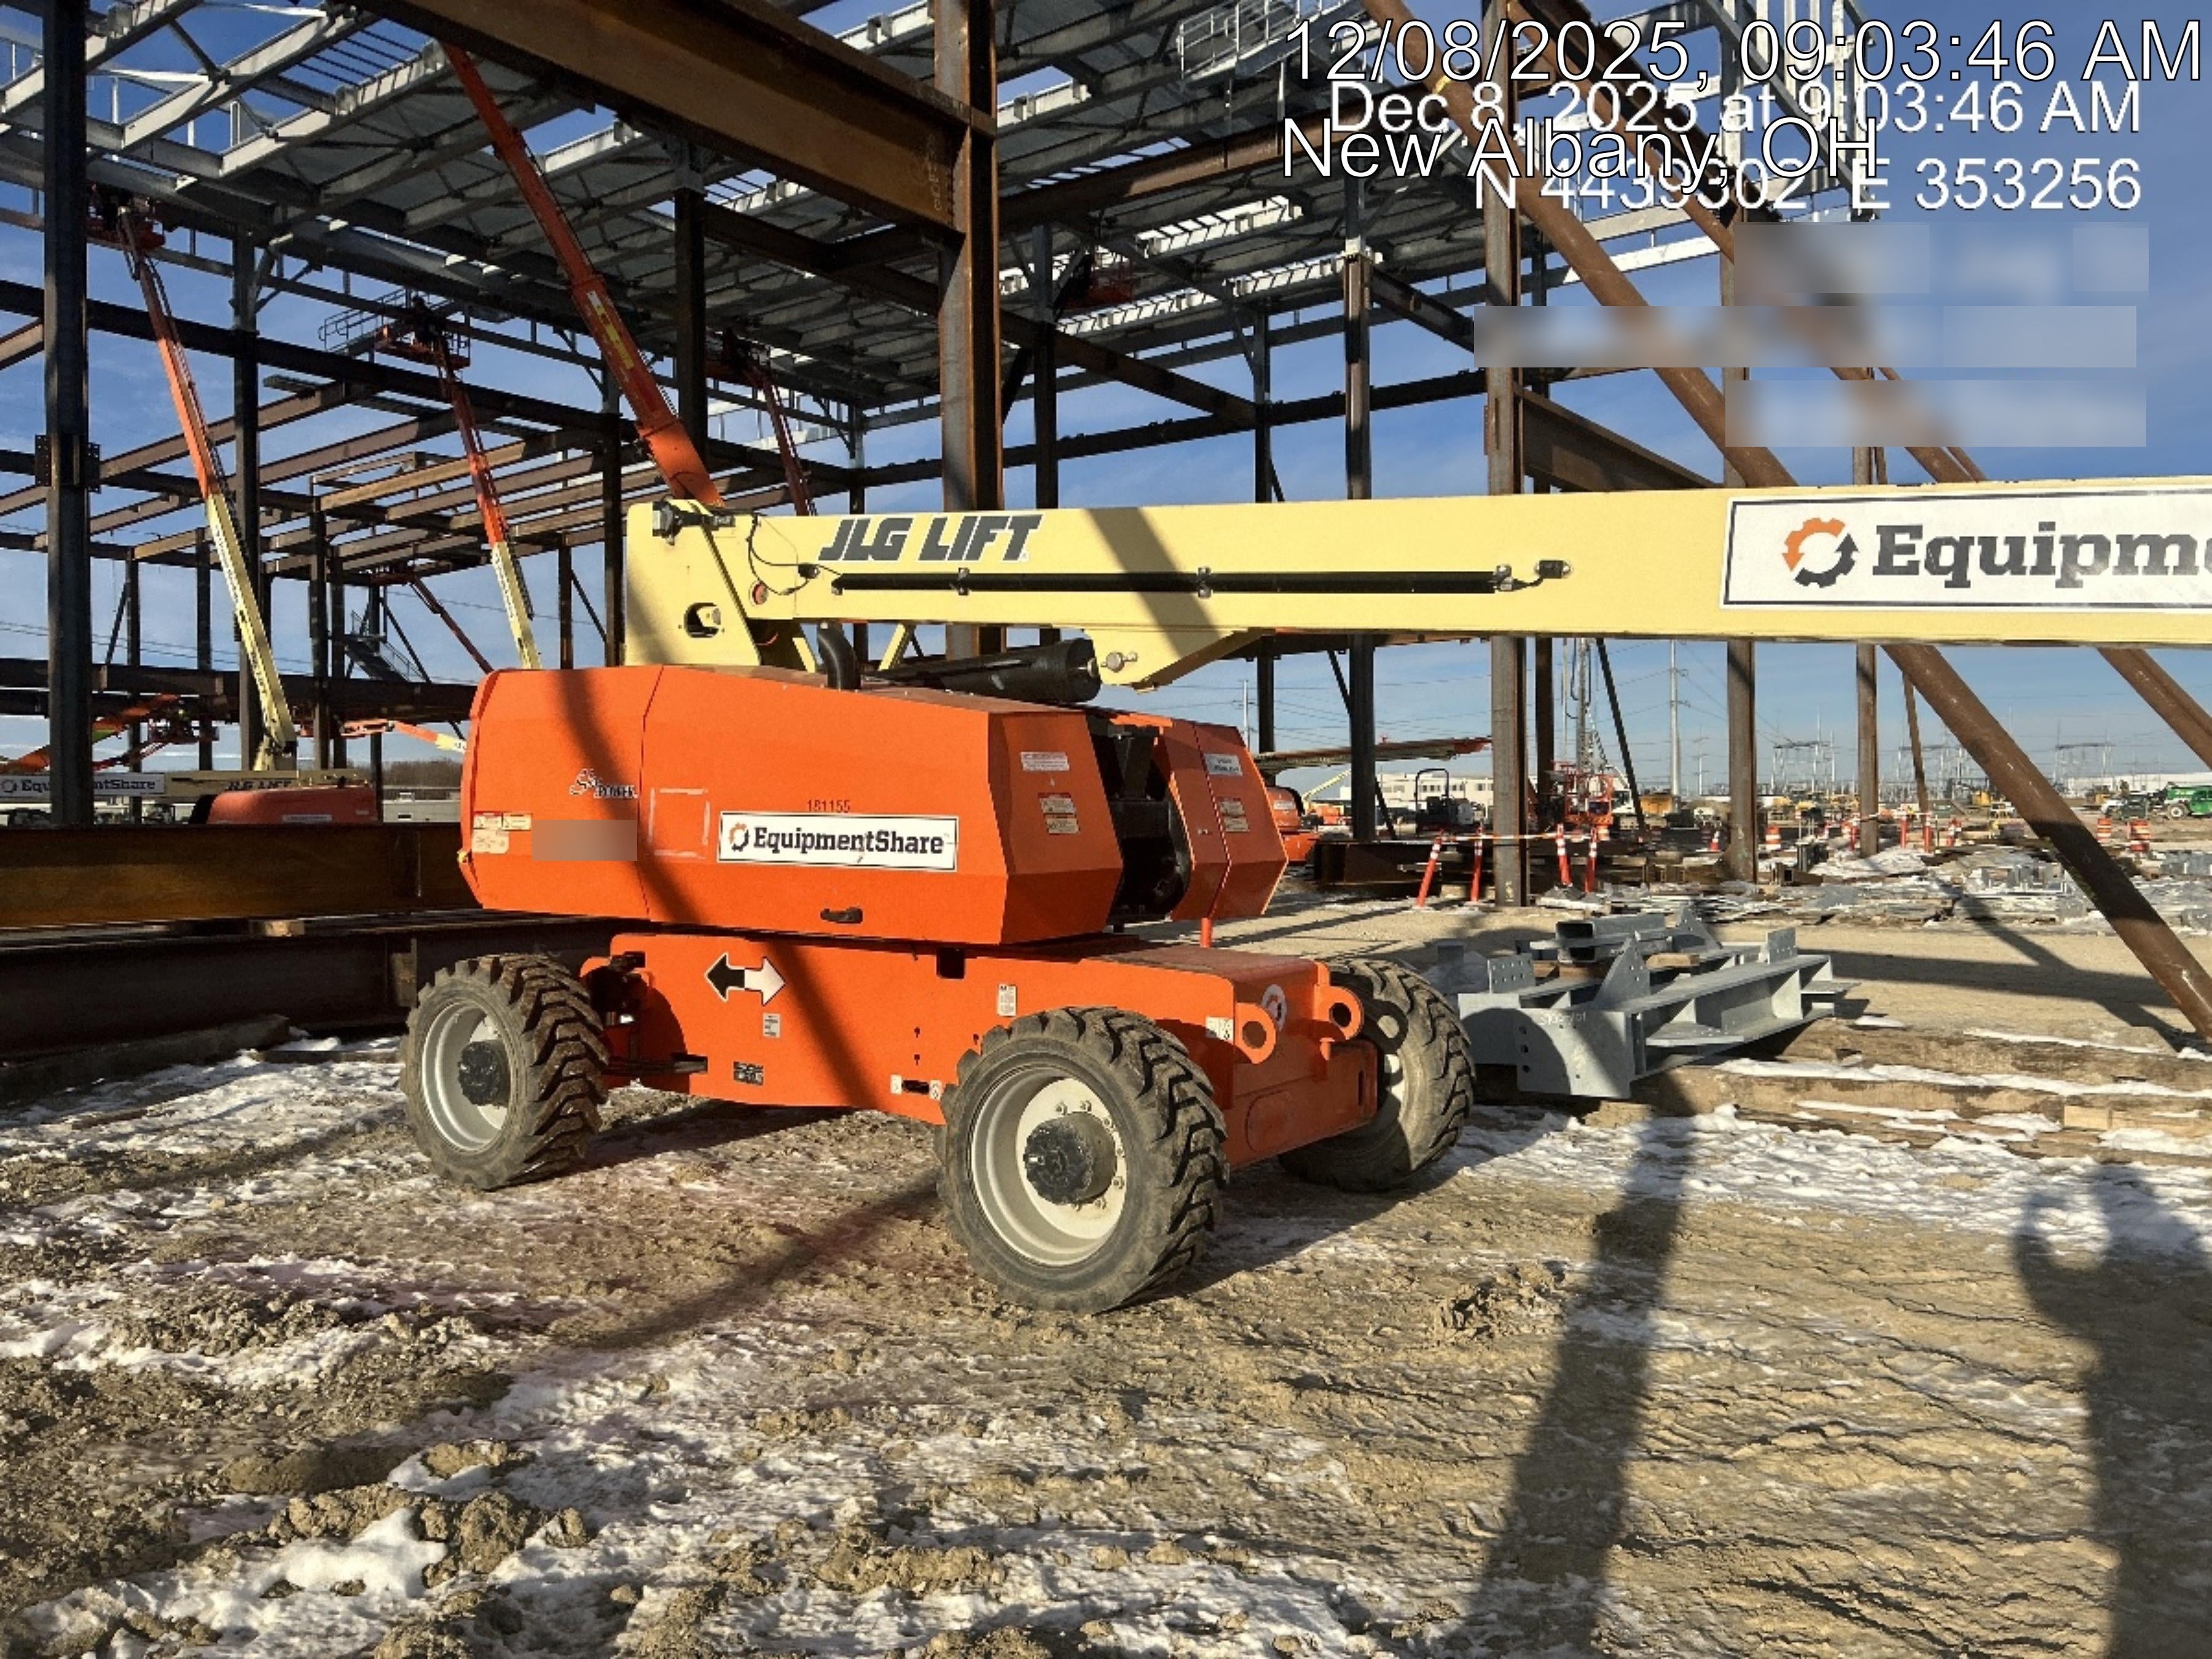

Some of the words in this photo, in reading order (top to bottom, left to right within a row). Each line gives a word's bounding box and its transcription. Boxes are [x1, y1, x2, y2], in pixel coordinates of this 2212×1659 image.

[817, 517, 915, 562] JLG
[917, 514, 1044, 562] LIFT
[1872, 520, 2212, 589] Equipm
[753, 826, 944, 854] EquipmentShare
